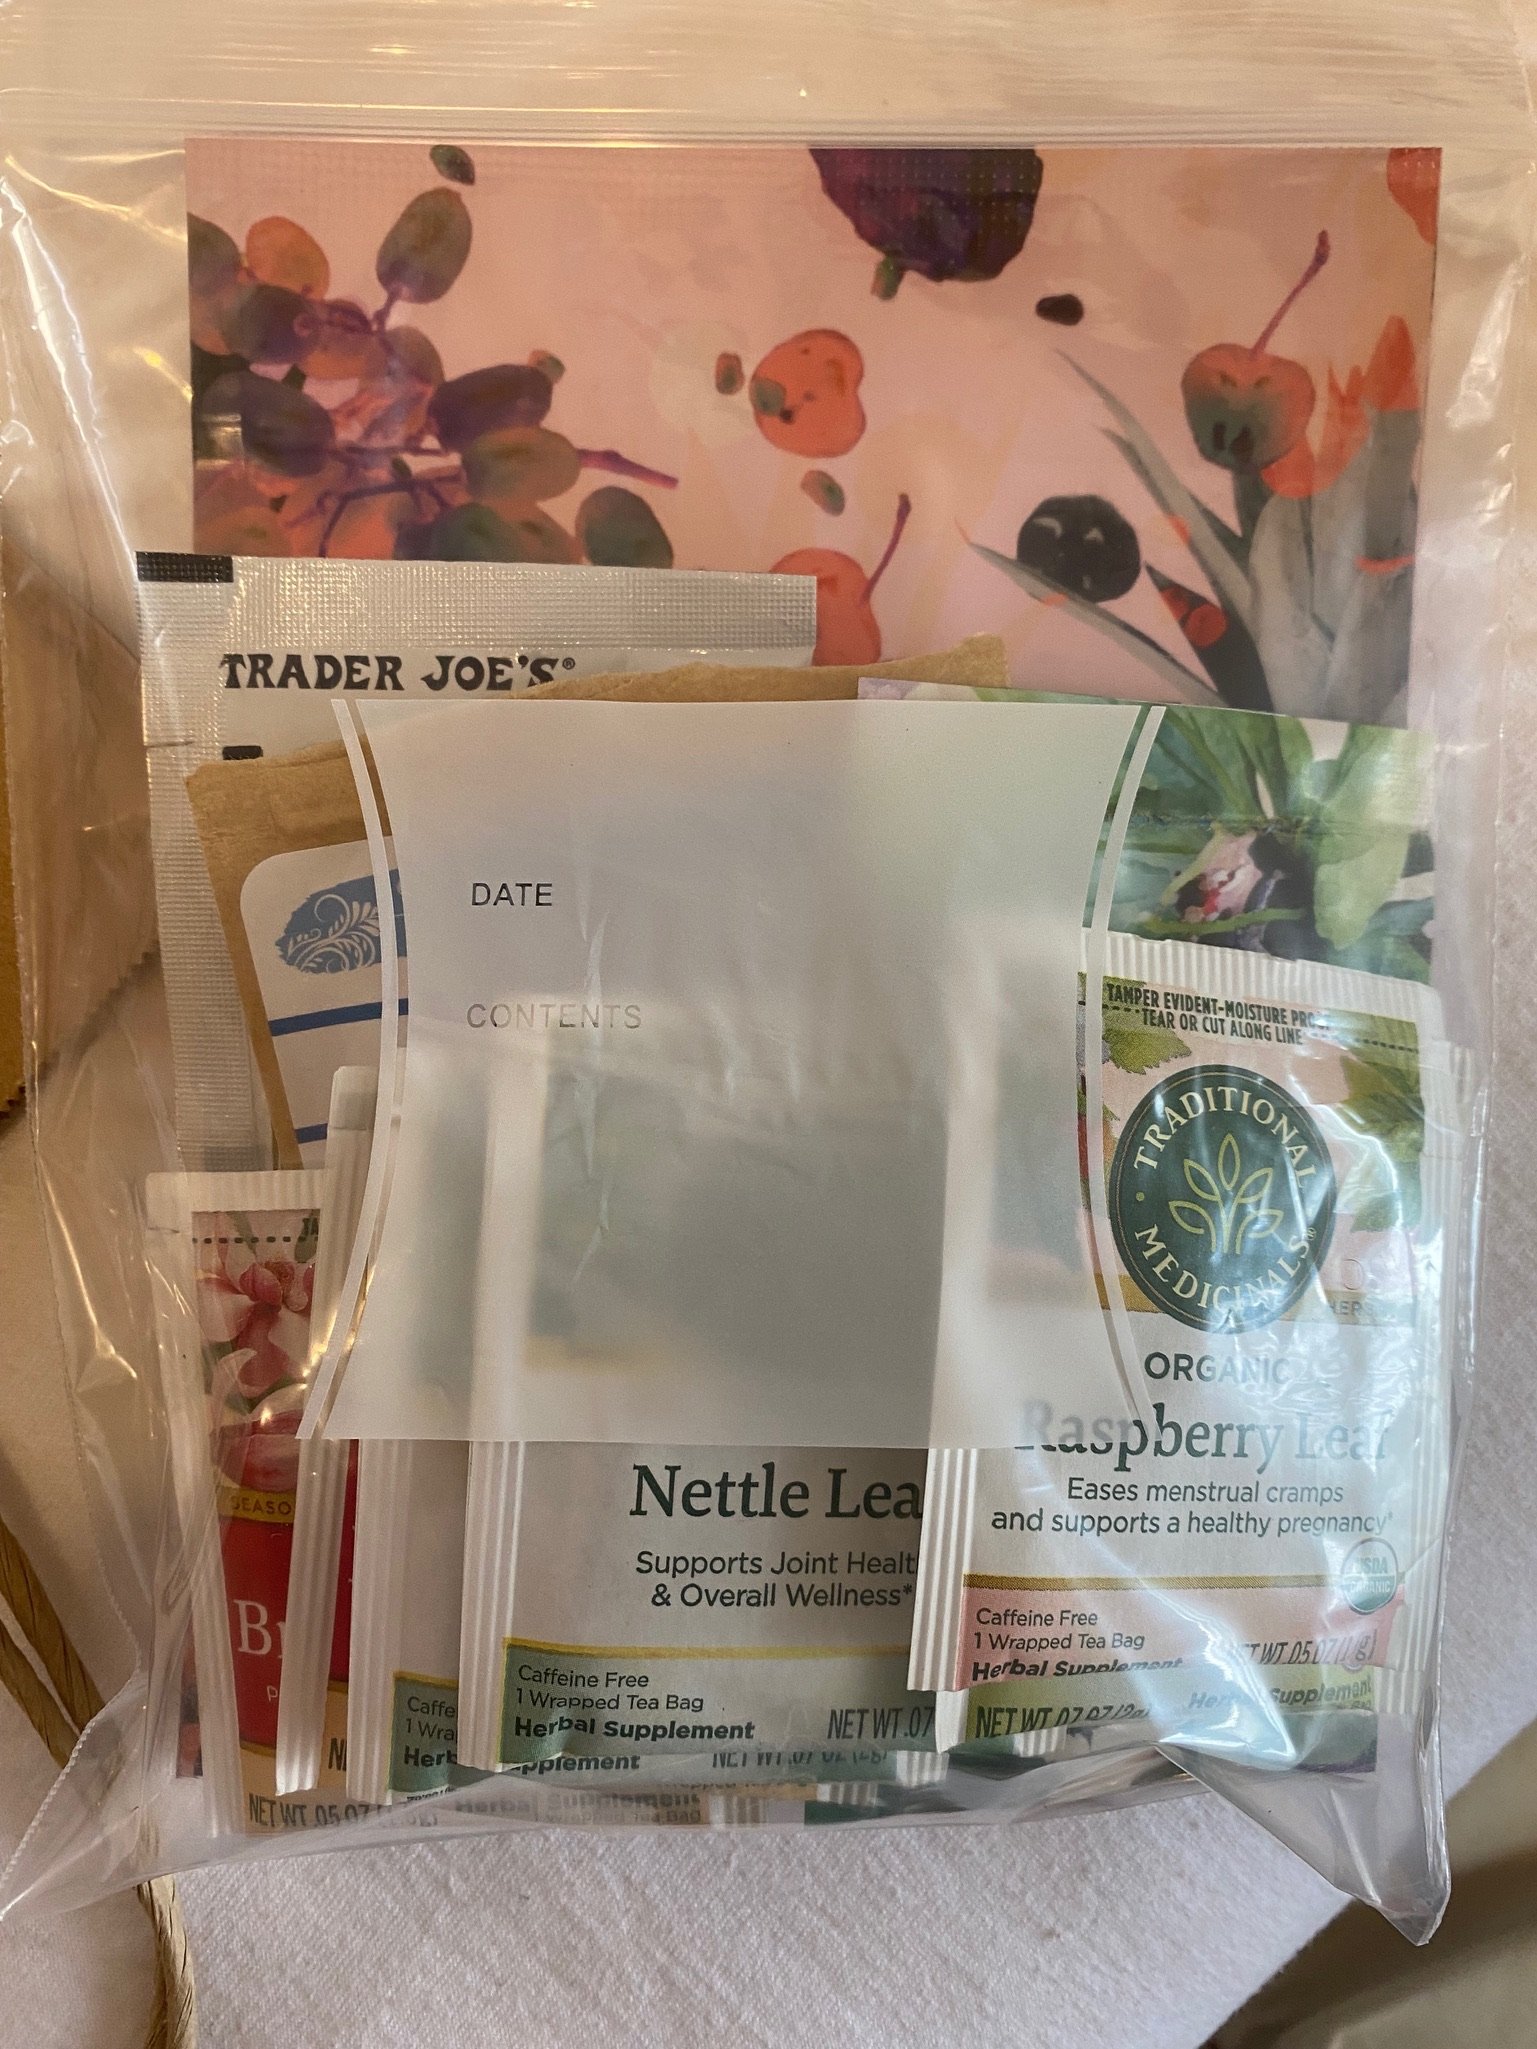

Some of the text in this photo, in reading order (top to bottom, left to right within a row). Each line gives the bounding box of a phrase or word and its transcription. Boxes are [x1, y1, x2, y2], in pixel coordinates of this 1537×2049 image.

[220, 653, 405, 691] TRADER
[471, 882, 553, 907] DATE
[466, 1003, 642, 1029] CONTENTS
[1106, 983, 1331, 1031] TAMPER EVIDENT-MOISTURE PRO
[1142, 1008, 1304, 1046] TEAR OR CUT ALONG LINE
[1133, 1086, 1317, 1188] TRADITIONAL
[1144, 1351, 1292, 1383] ORGANIC
[1014, 1400, 1284, 1475] Raspberry
[629, 1461, 809, 1518] Nettle
[1067, 1477, 1345, 1507] Eases menstrual cramps
[991, 1508, 1044, 1533] and
[1051, 1511, 1160, 1537] supports
[1167, 1517, 1181, 1534] a
[1187, 1511, 1269, 1537] healthy
[636, 1551, 918, 1578] Supports Joint Healt
[651, 1583, 671, 1607] &
[680, 1583, 777, 1607] Overall
[976, 1607, 1098, 1627] Caffeine Free
[974, 1632, 1146, 1652] 1 Wrapped Tea Bag
[518, 1665, 649, 1687] Caffeine Free
[972, 1656, 1184, 1681] Herbal Supplement
[516, 1687, 704, 1712] 1 Wrapped Tea Bag
[405, 1718, 458, 1741] 1 Wra
[515, 1716, 756, 1741] Herbal Supplement
[827, 1709, 869, 1740] NET
[976, 1706, 1018, 1738] NET
[1021, 1707, 1053, 1733] WT
[249, 1793, 276, 1828] NET
[279, 1803, 307, 1827] WT
